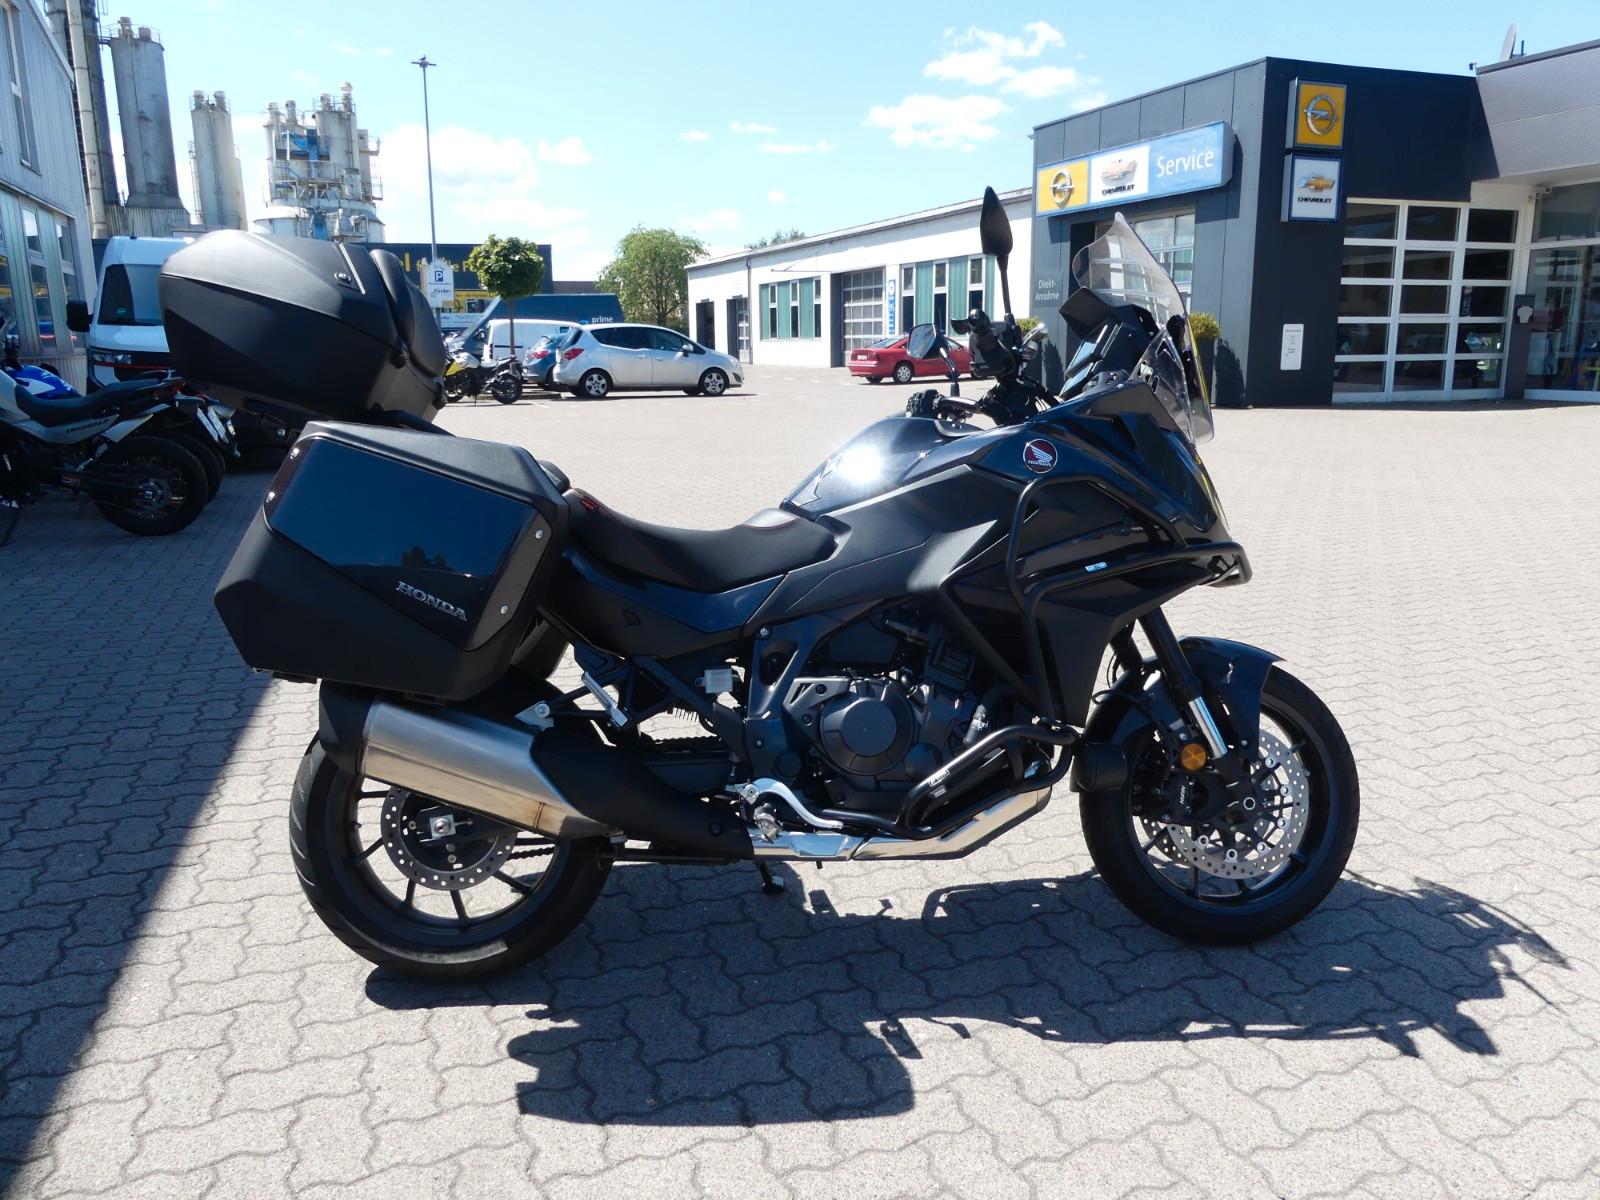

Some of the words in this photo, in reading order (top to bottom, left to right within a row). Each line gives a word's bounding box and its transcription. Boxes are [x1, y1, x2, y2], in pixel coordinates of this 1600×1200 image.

[1157, 149, 1215, 179] Service
[1101, 184, 1136, 197] CHEVROLET
[1297, 196, 1333, 204] CHEVROLET
[591, 315, 614, 324] prime
[66, 418, 111, 434] TRANSALP
[395, 580, 468, 622] HONDA
